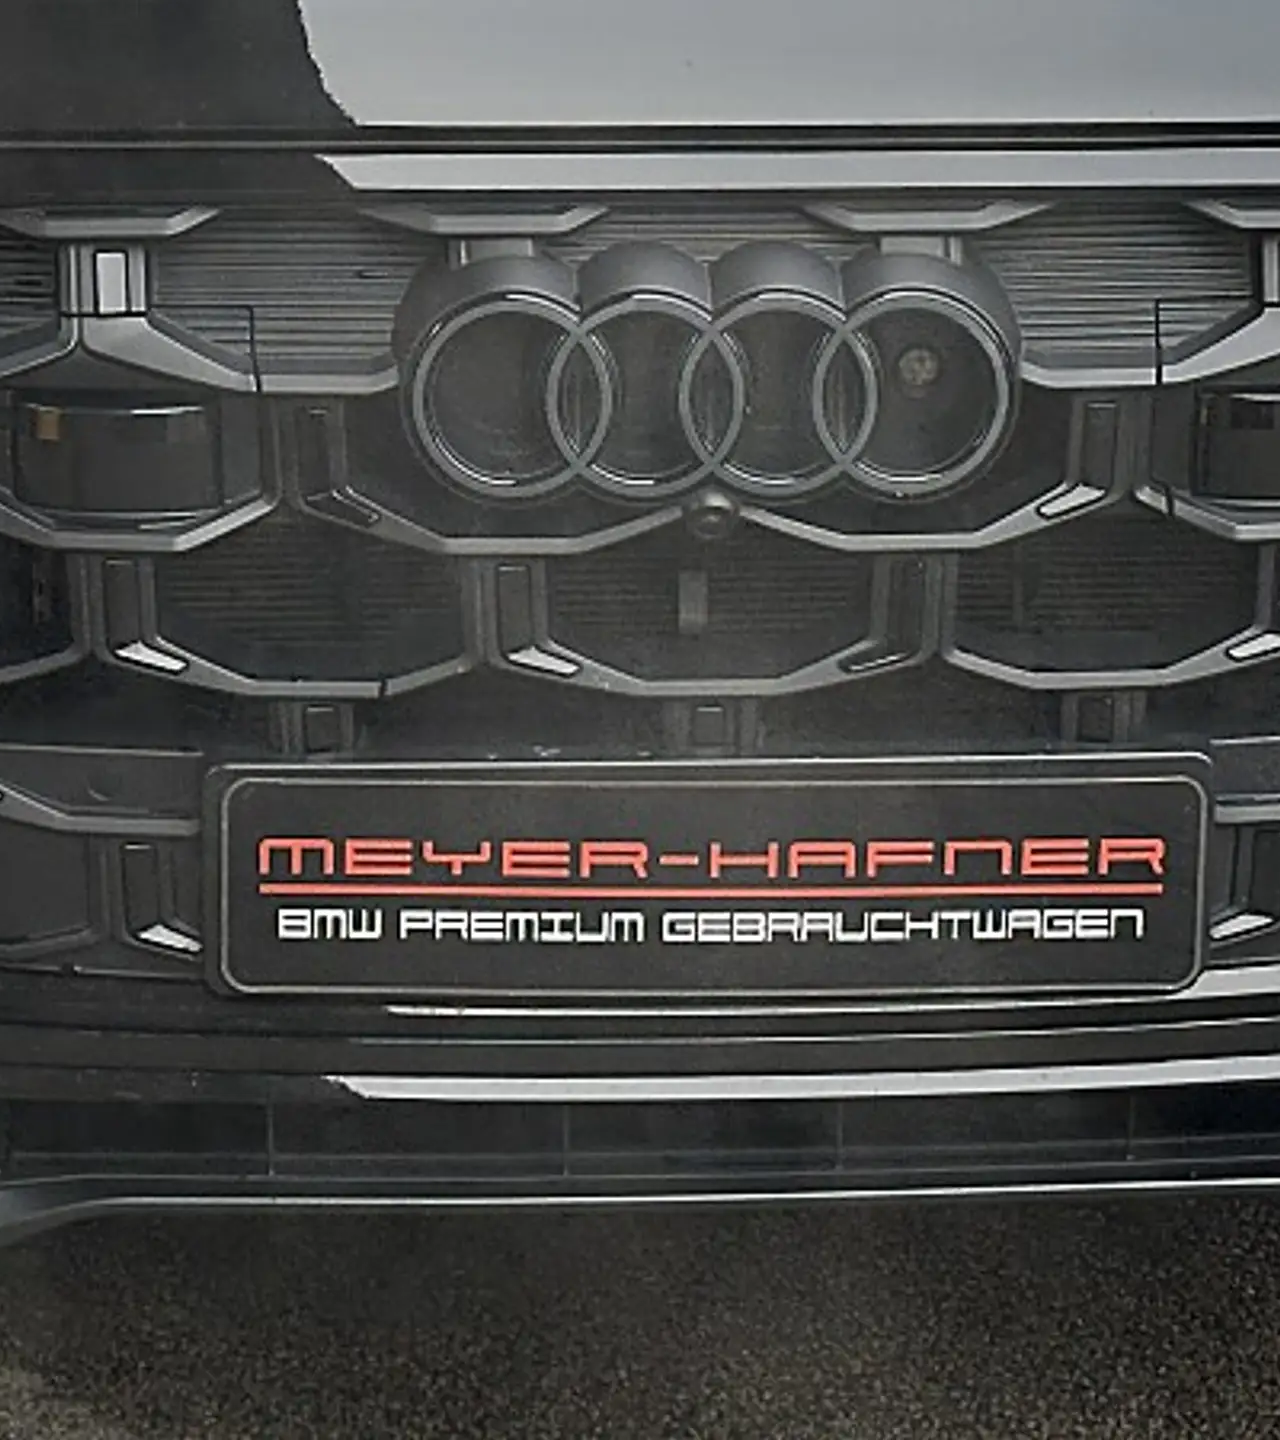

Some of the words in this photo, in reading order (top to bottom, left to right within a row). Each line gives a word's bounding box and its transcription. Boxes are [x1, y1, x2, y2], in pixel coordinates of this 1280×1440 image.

[258, 837, 1165, 879] MEYER-HAFNER
[277, 907, 383, 940] BMW
[398, 909, 645, 943] PREMIUM
[661, 907, 1144, 943] GEBRAUCHTWAGEN
